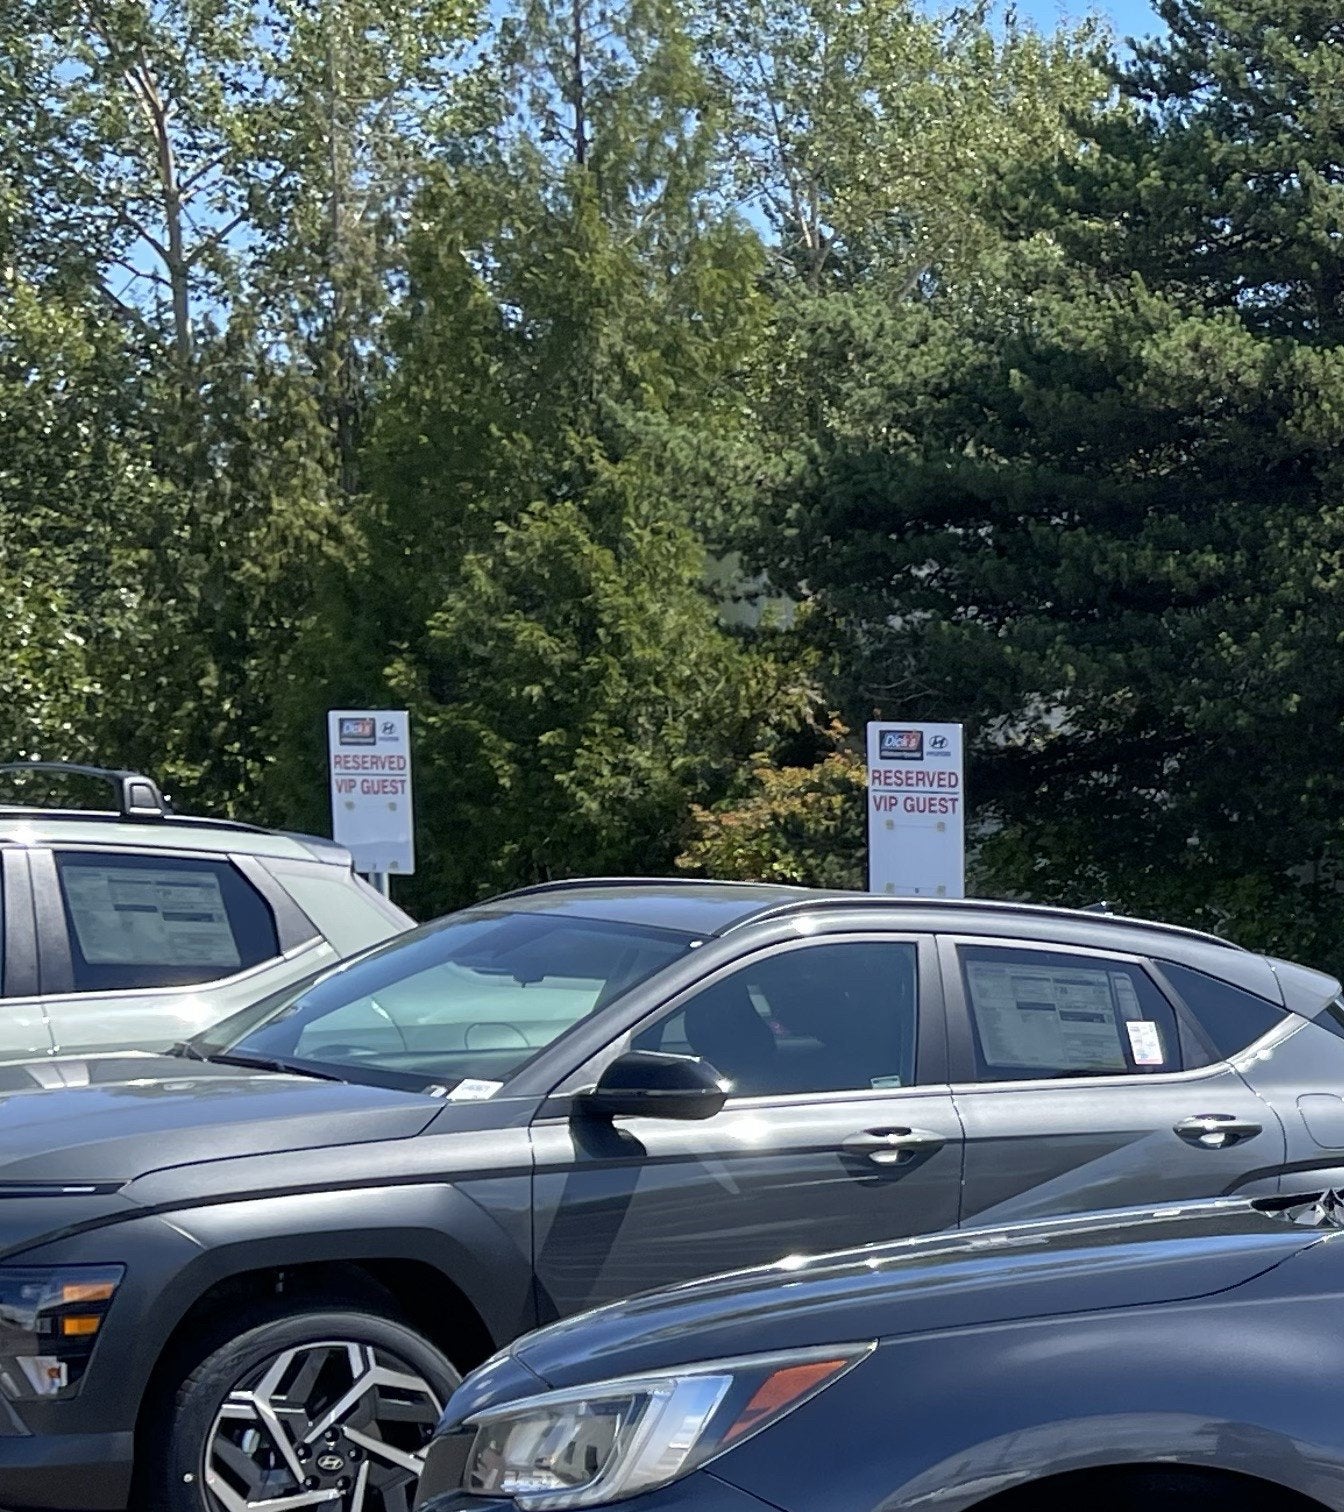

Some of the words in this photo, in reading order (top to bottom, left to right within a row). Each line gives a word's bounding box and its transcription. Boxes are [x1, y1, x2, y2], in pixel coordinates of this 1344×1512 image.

[334, 754, 406, 771] RESERVED
[335, 778, 357, 794] VIP
[361, 778, 406, 795] GUEST
[871, 769, 959, 788] RESERVED
[873, 794, 898, 812] VIP
[903, 796, 959, 814] GUEST
